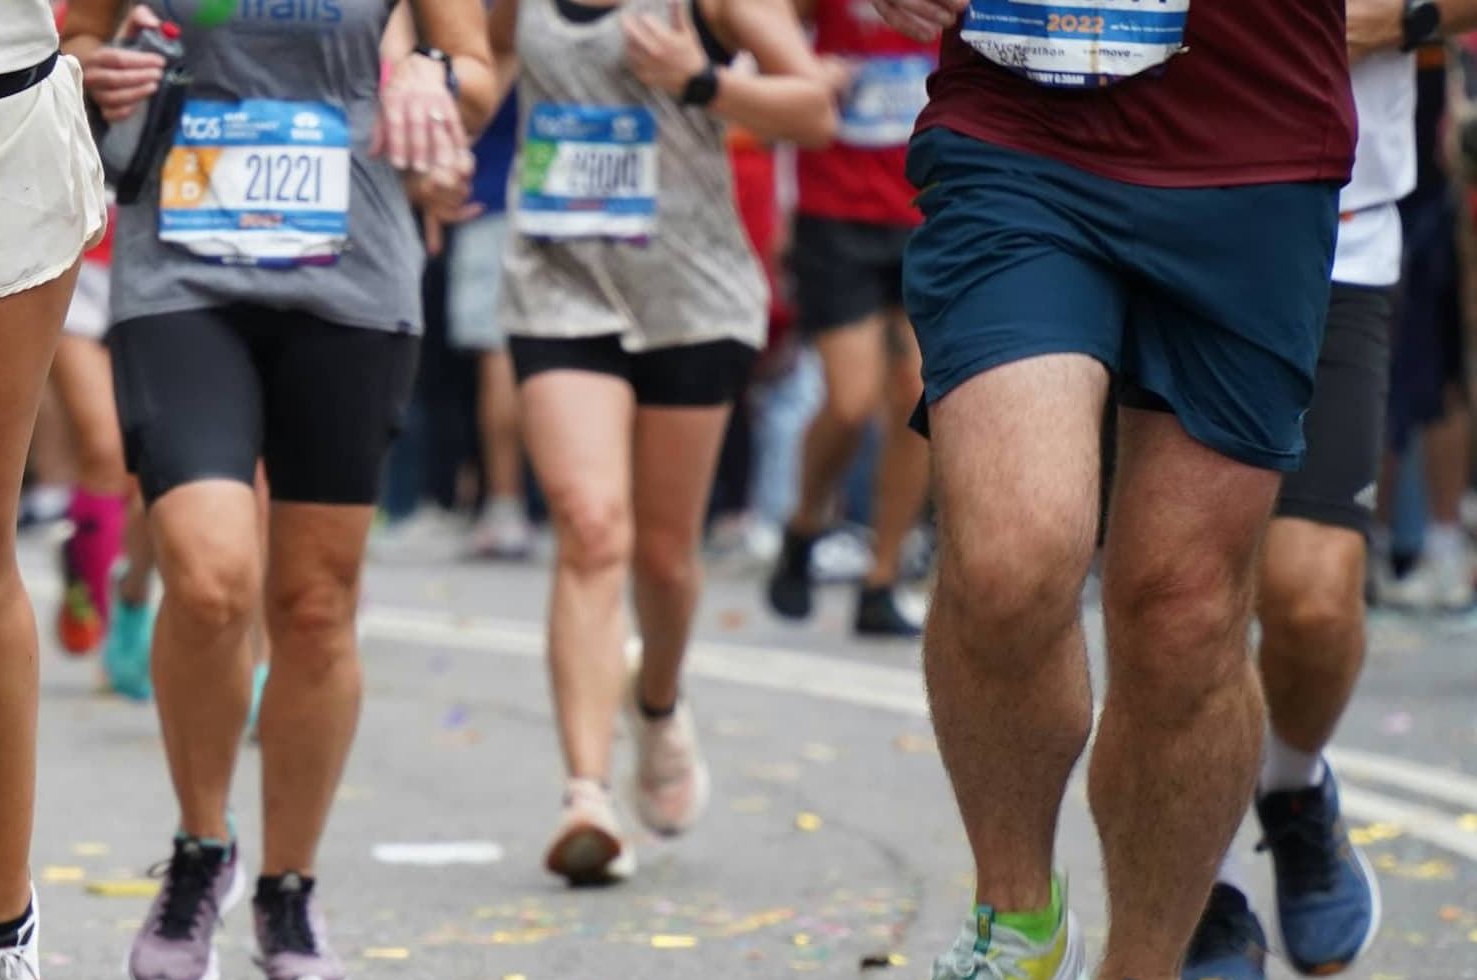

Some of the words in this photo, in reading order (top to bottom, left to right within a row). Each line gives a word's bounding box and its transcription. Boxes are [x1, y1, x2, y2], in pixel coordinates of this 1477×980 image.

[1047, 13, 1106, 34] 2022
[181, 113, 221, 139] tcs
[245, 153, 322, 204] 21221
